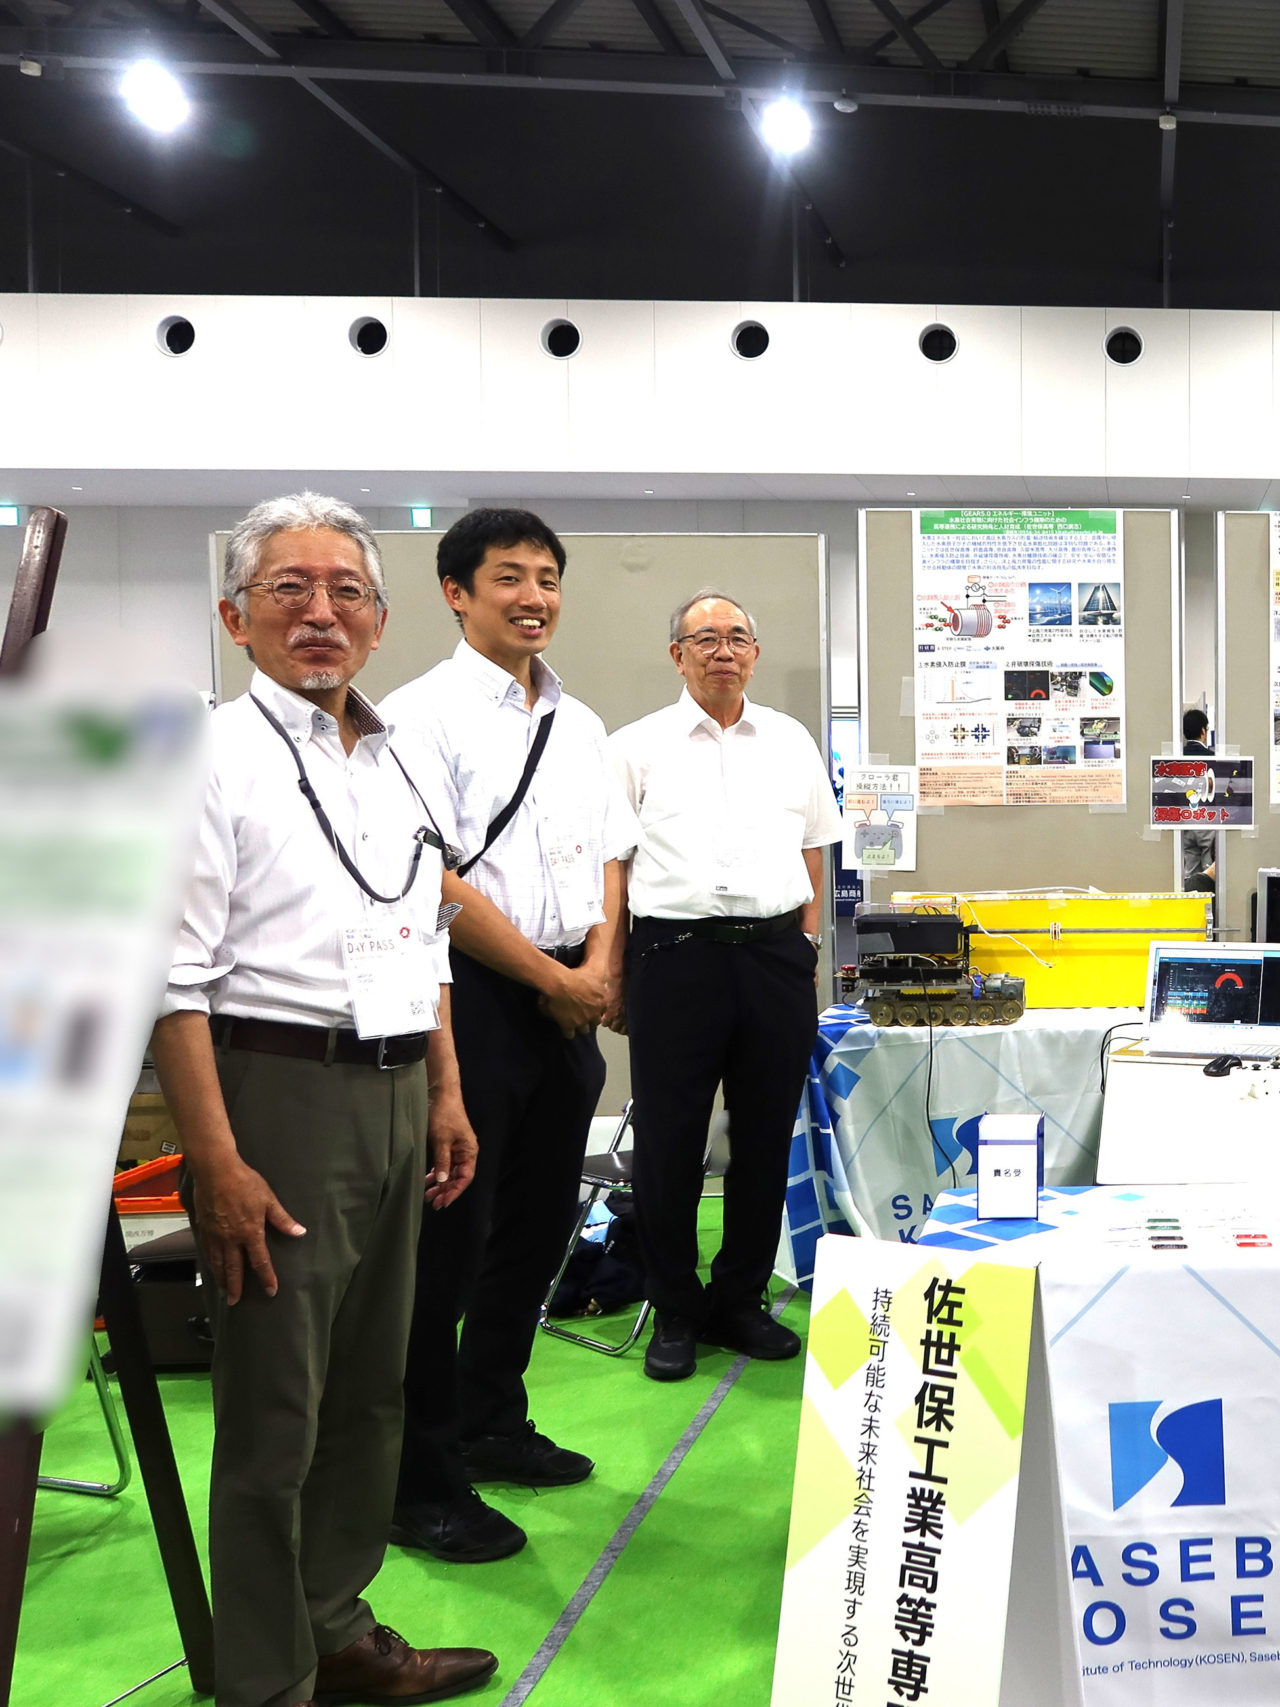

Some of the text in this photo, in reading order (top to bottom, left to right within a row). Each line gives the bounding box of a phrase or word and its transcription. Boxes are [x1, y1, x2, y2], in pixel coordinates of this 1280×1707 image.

[369, 939, 395, 952] PASS
[886, 1276, 966, 1707] 佐世保工業高等専
[1082, 1664, 1109, 1677] itute
[1112, 1662, 1125, 1674] of
